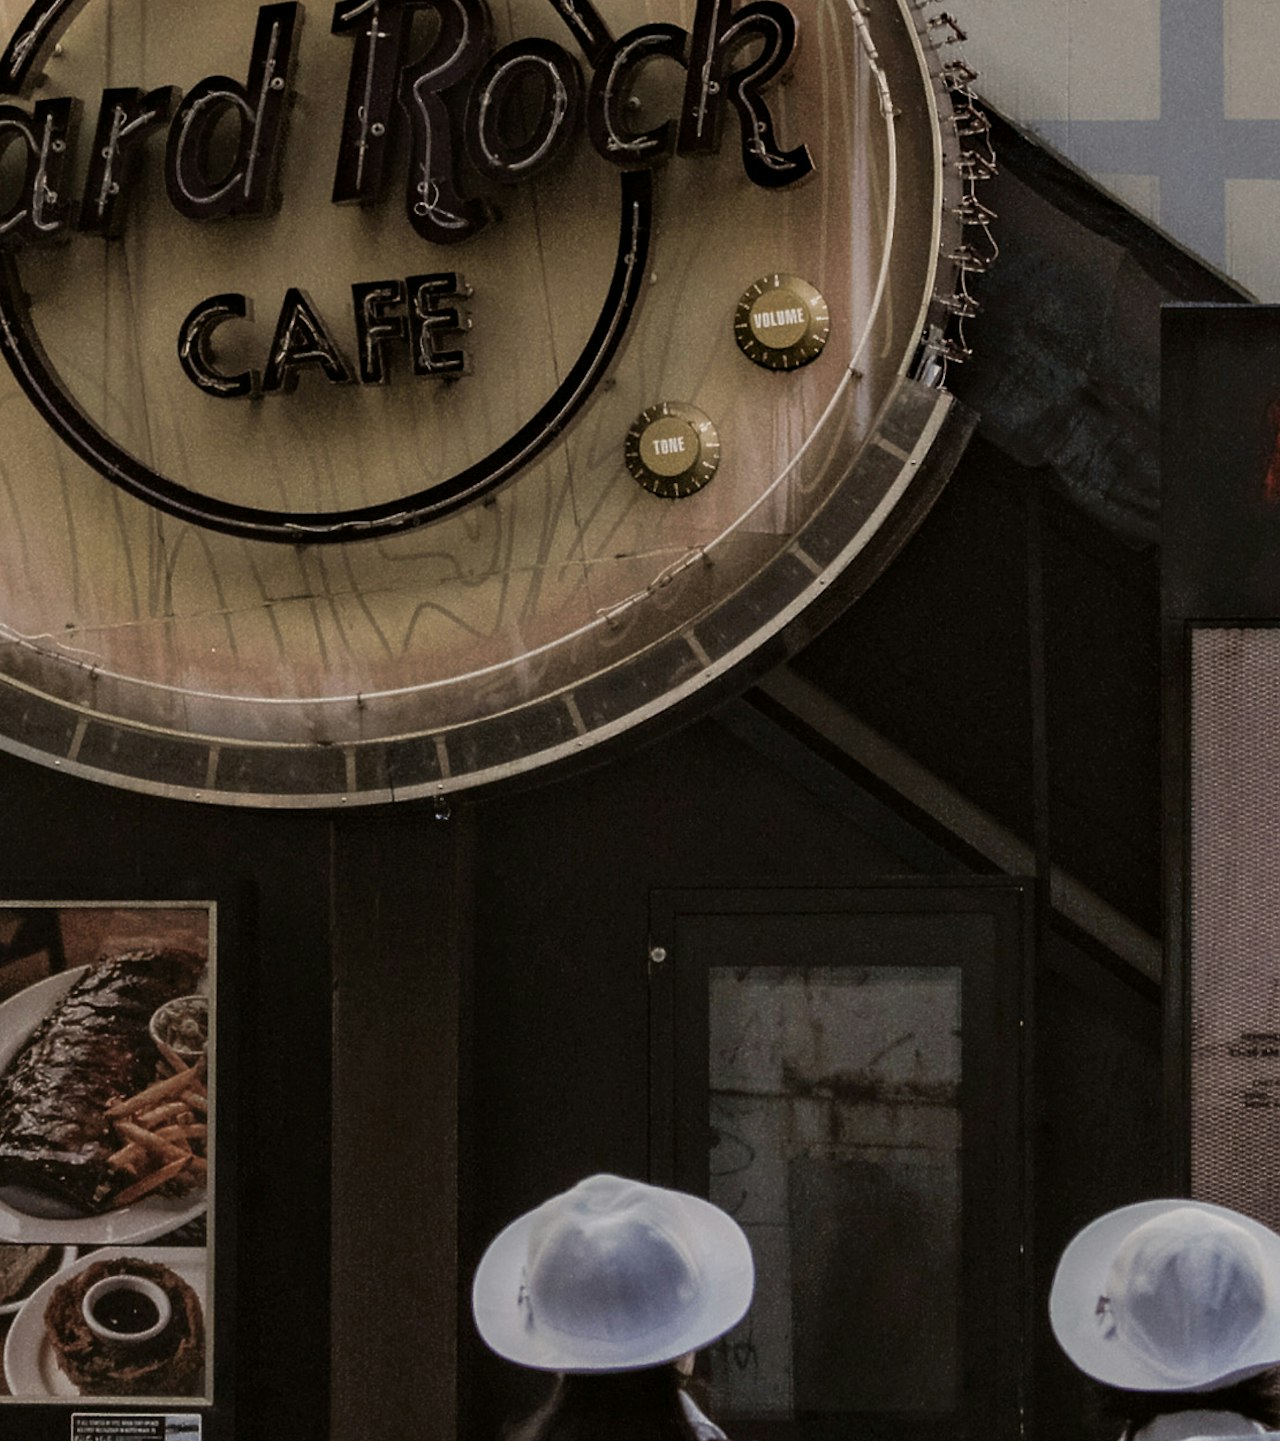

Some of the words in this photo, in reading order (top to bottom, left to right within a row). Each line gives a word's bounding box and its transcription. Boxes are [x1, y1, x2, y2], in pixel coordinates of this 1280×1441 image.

[753, 308, 805, 329] VOLUME
[177, 270, 473, 401] CAFE
[652, 436, 685, 455] TONE
